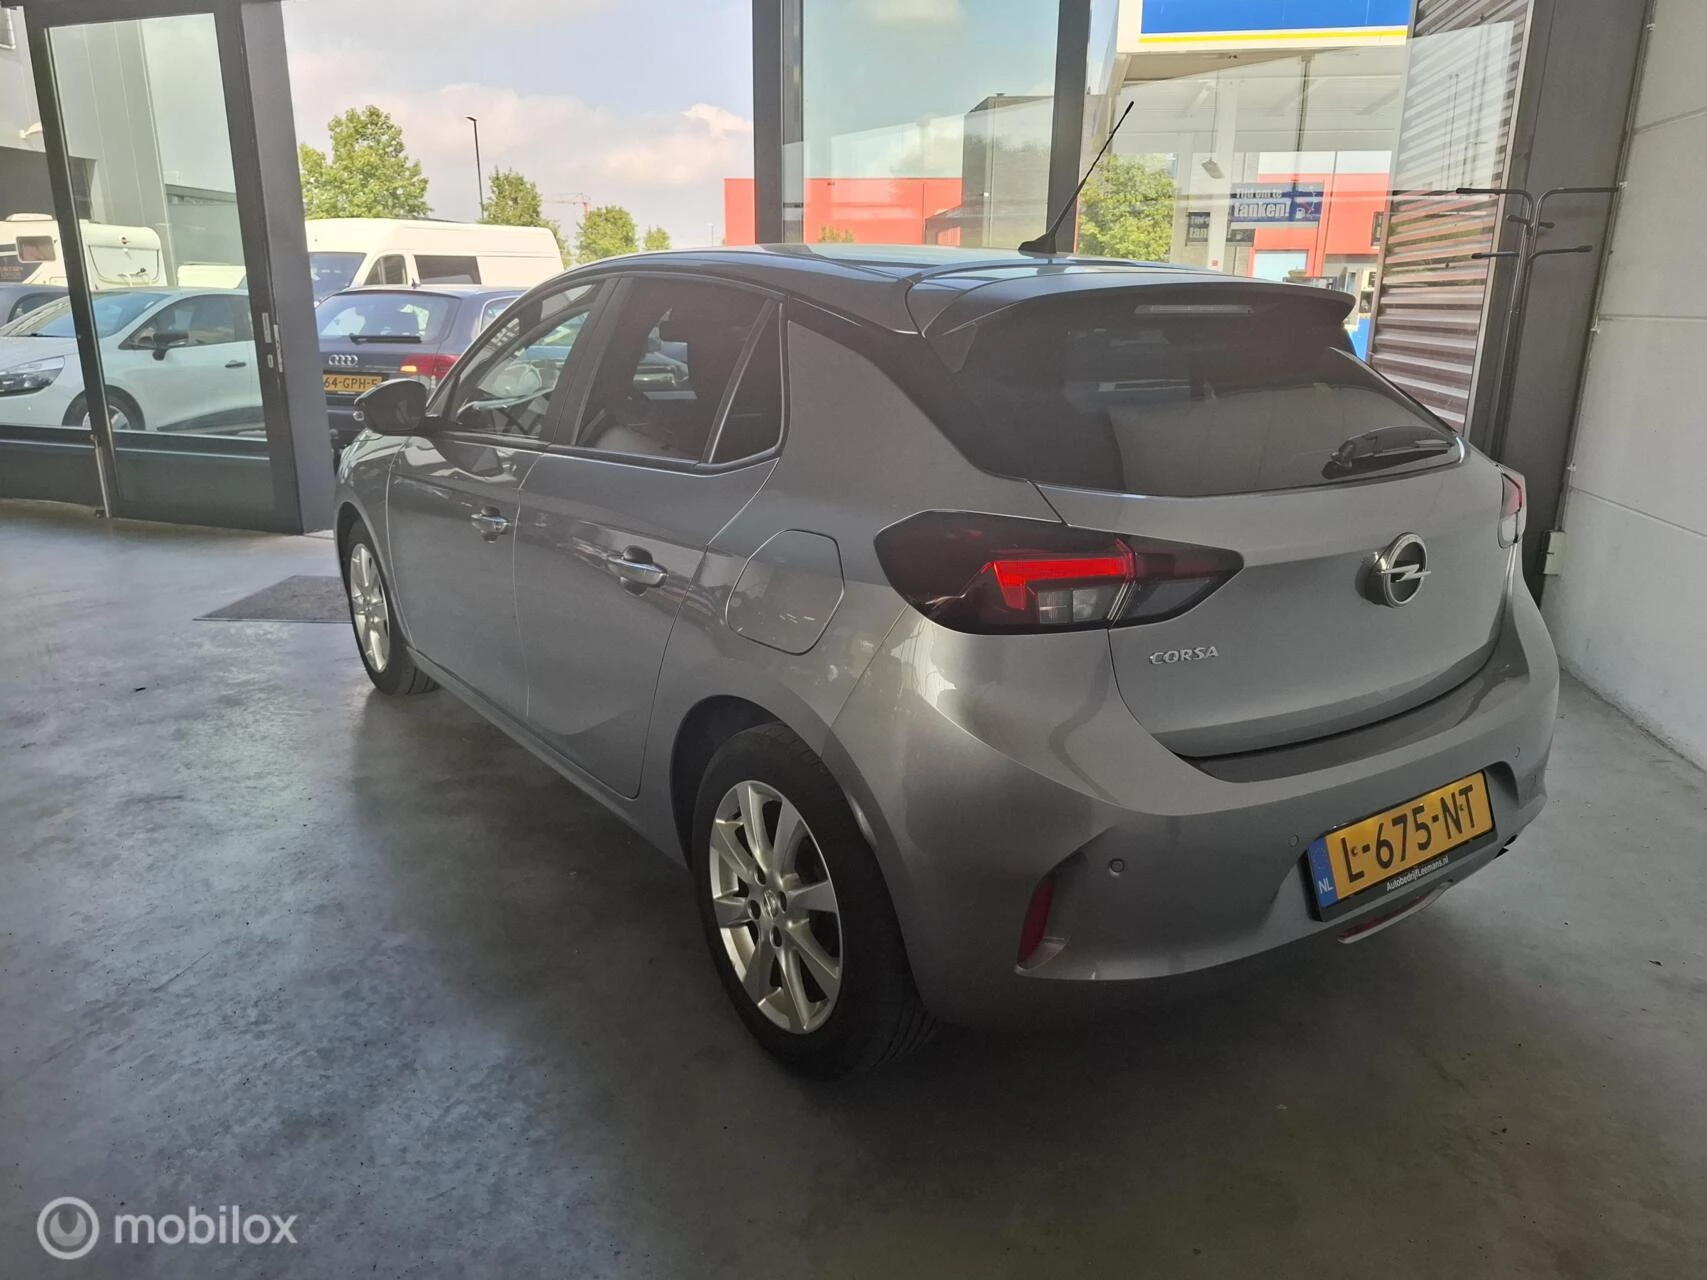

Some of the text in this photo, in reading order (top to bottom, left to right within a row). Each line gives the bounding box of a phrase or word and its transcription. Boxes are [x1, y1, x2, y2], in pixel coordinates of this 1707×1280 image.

[1233, 200, 1292, 217] tanken!
[1149, 646, 1219, 665] CORSA
[1340, 784, 1474, 884] L-675-NT
[1318, 877, 1334, 895] NL
